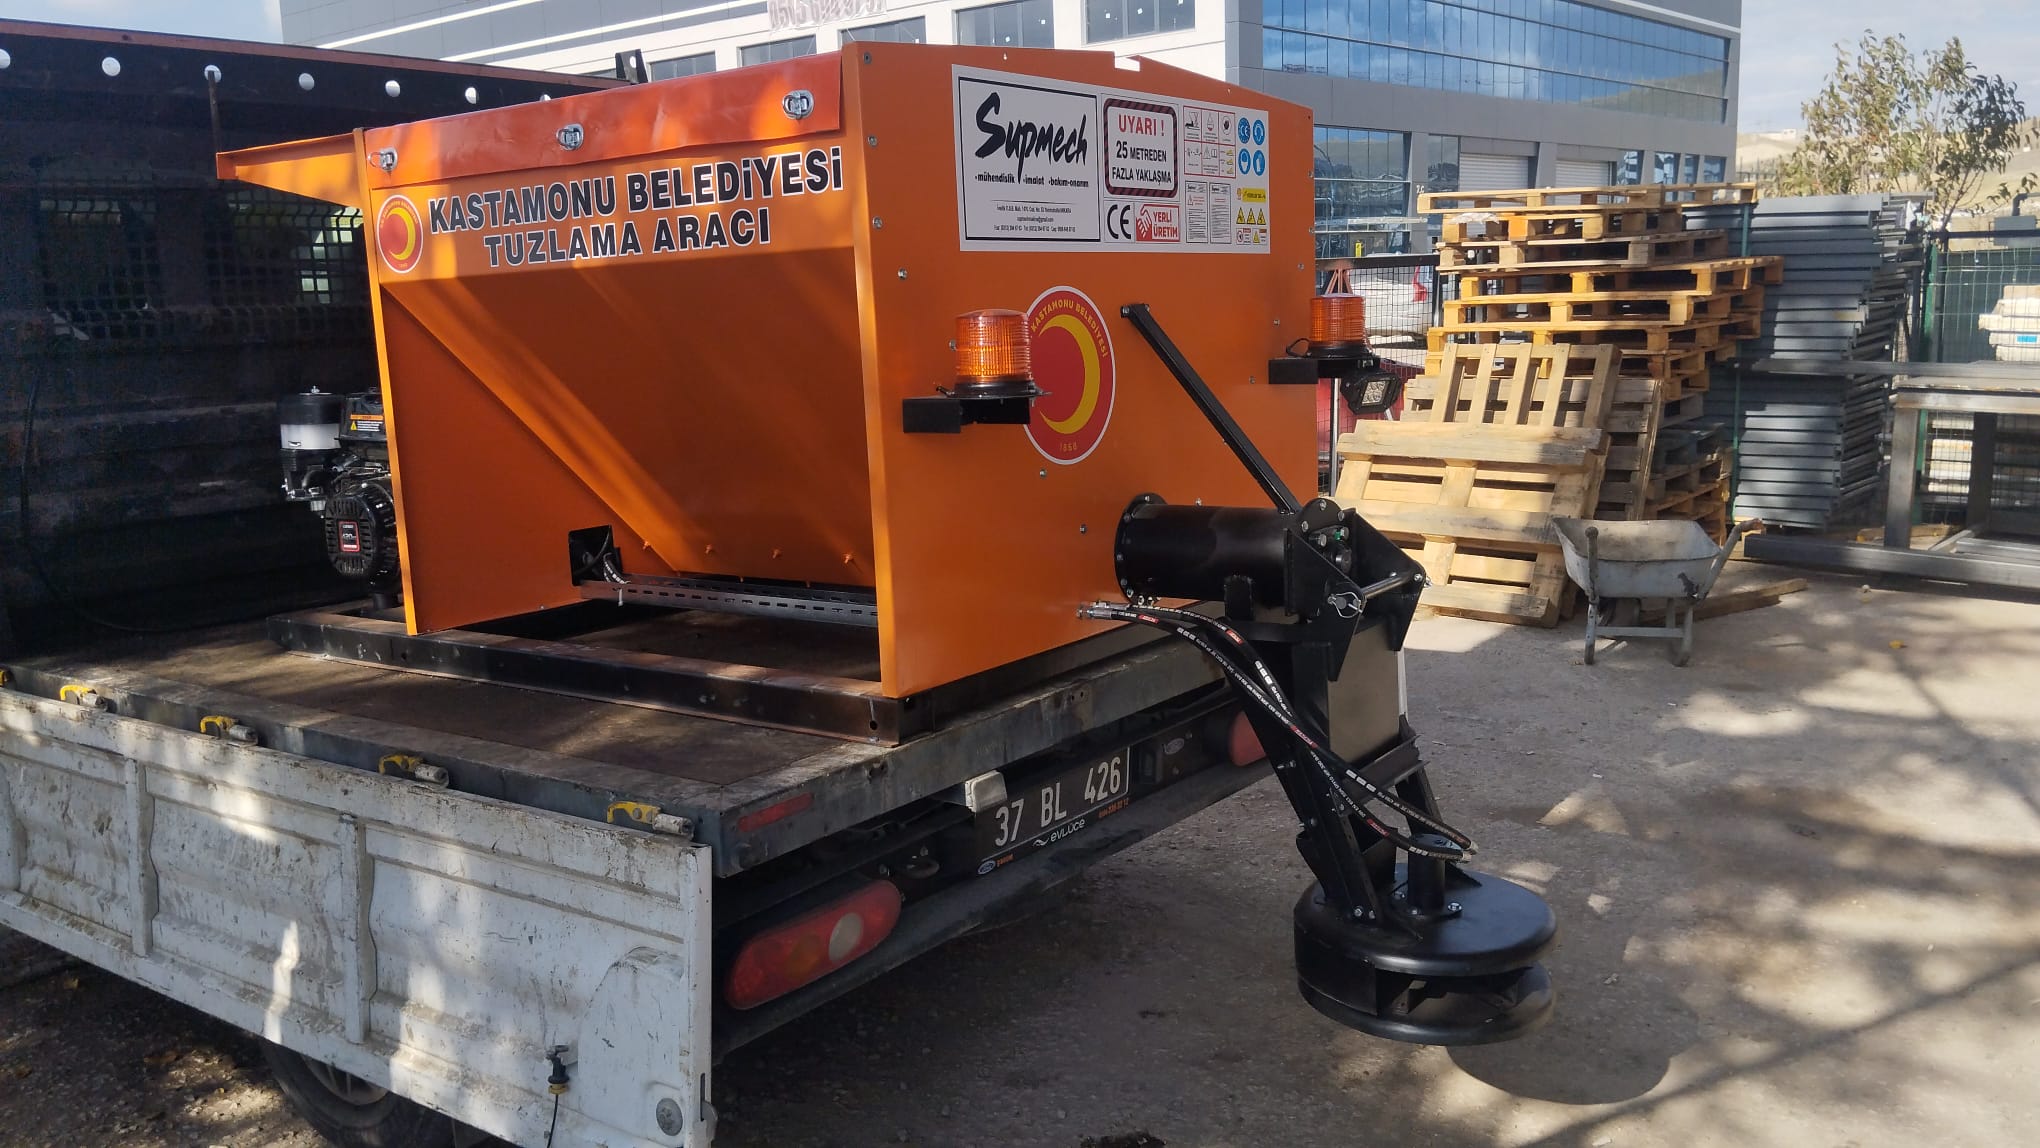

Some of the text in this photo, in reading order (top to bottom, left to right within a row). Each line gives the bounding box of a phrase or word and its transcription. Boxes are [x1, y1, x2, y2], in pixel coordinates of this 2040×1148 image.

[975, 92, 1087, 184] Supmech
[1118, 113, 1157, 137] UYARI
[1116, 140, 1167, 163] 25 METREDEN
[1112, 166, 1171, 186] FAZLA YAKLAŞMA
[428, 176, 616, 234] KASTAMONU
[1107, 204, 1131, 239] CE
[1153, 209, 1172, 222] YERLİ
[484, 206, 770, 268] TUZLAMA ARACI
[1153, 223, 1177, 237] ÜRETİM
[1031, 299, 1074, 333] KASTAMONU
[994, 799, 1024, 847] 37
[1041, 783, 1067, 828] BL
[1084, 757, 1121, 804] 426
